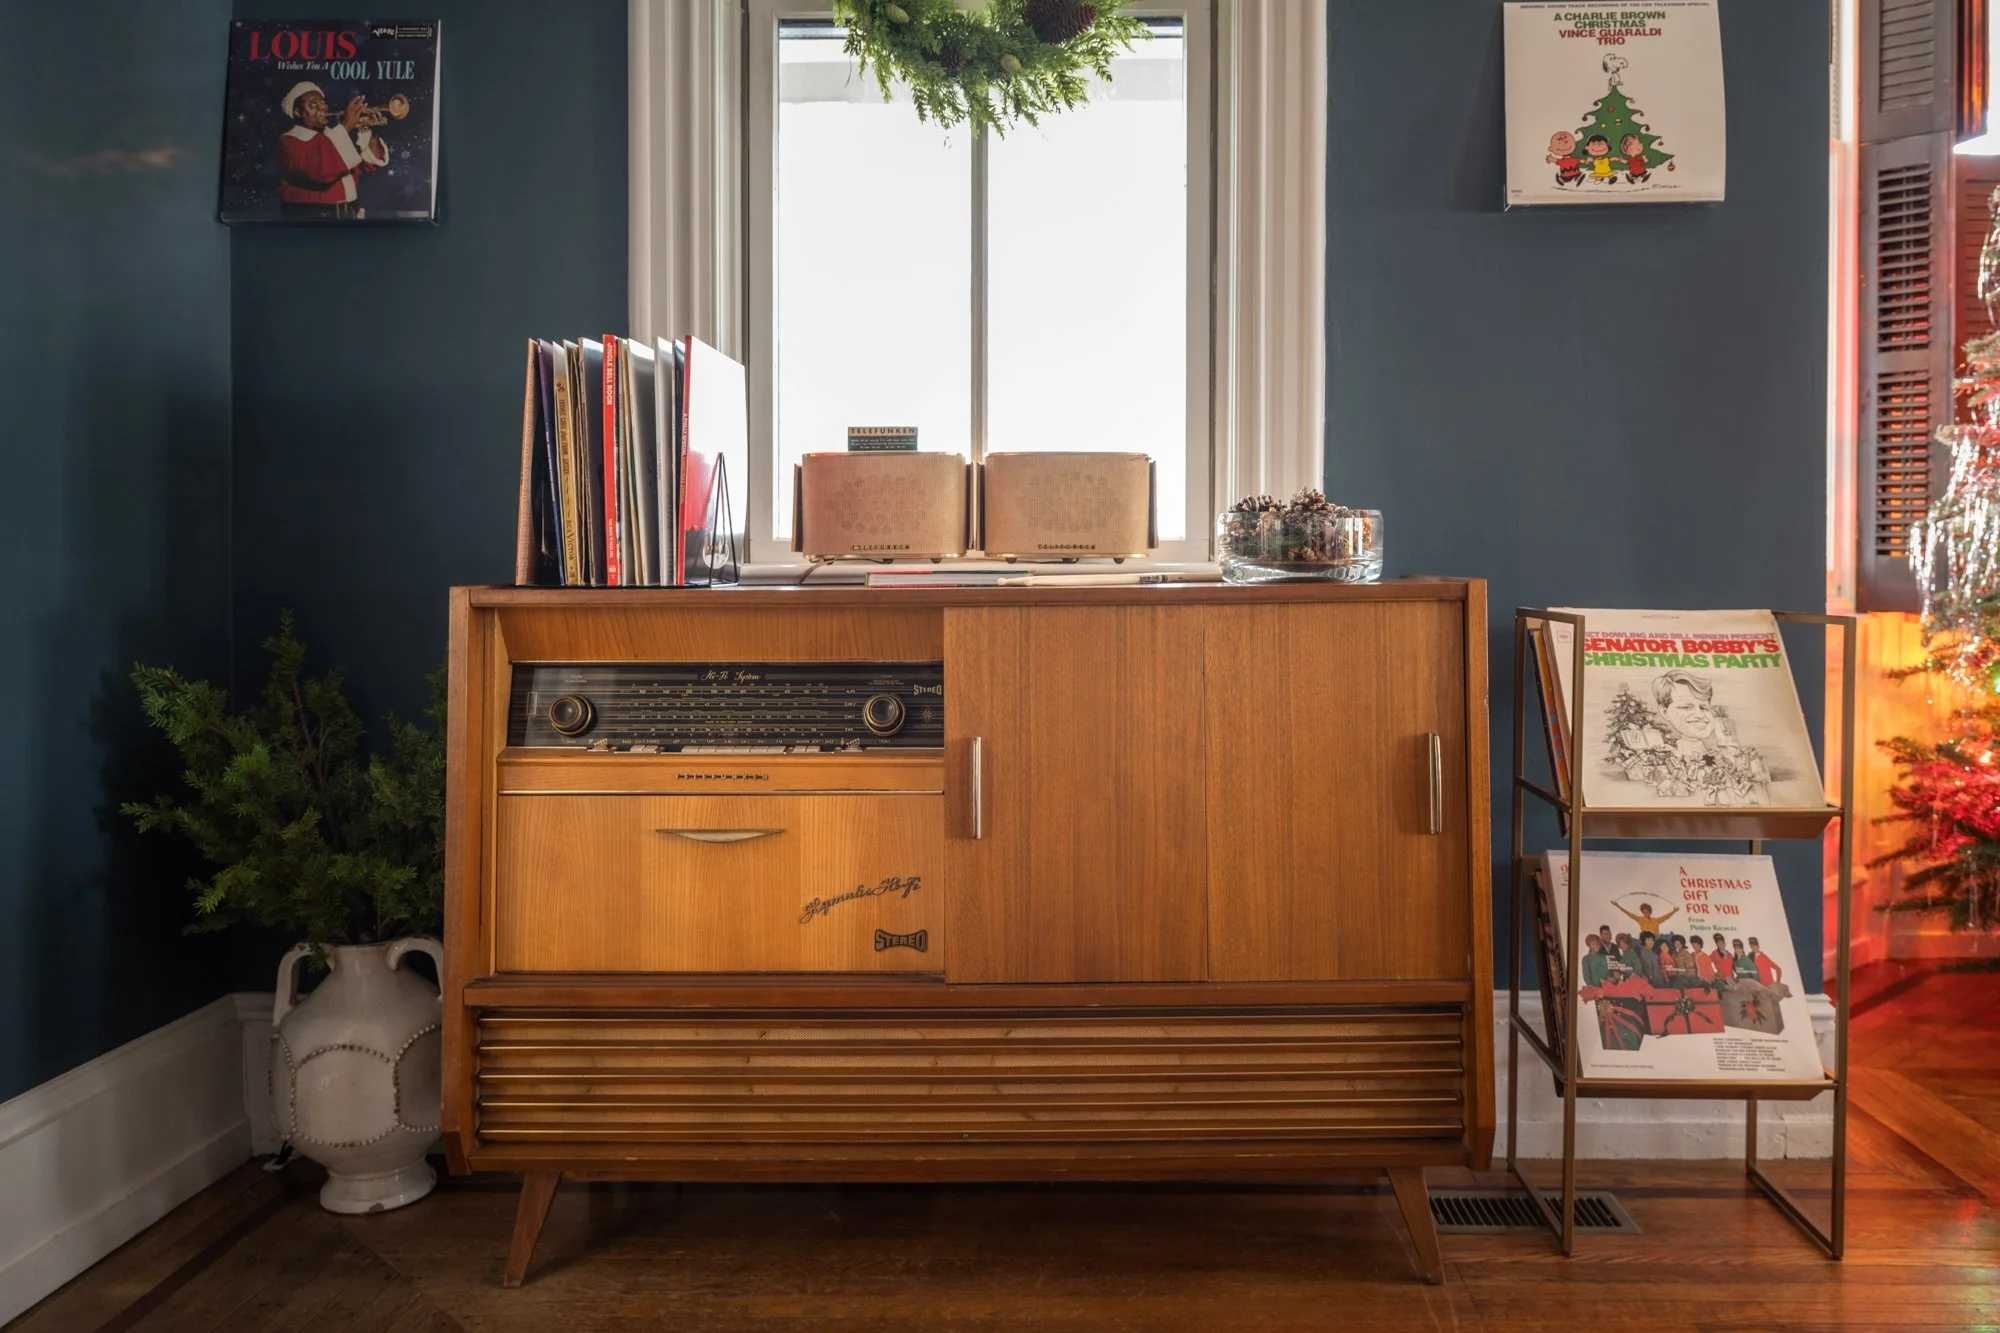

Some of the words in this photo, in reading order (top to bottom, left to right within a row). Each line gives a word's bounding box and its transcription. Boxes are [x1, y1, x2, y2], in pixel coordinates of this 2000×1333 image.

[1554, 12, 1562, 21] A
[1564, 12, 1618, 21] CHARLIE
[1620, 11, 1666, 19] BROWN
[1574, 20, 1646, 29] CHRISTMAS
[1559, 29, 1596, 38] VINCE
[1599, 28, 1662, 37] GUARALDI
[248, 30, 356, 61] LOUIS
[1596, 37, 1626, 45] TRIO
[278, 61, 304, 70] Wishes
[306, 61, 320, 70] You
[322, 61, 329, 70] A
[330, 61, 370, 80] COOL
[376, 61, 415, 80] YULE
[1584, 638, 1679, 653] SENATOR
[1682, 639, 1779, 653] BOBBY'S
[1584, 652, 1710, 668] CHRISTMAS
[1712, 653, 1782, 668] PARTY
[914, 684, 942, 696] STEREO
[1680, 866, 1687, 876] A
[1680, 878, 1752, 889] CHRISTMAS
[1683, 890, 1708, 900] GIFT
[1686, 903, 1710, 914] FOR
[1714, 904, 1739, 915] YOU
[875, 930, 926, 952] STEREO
